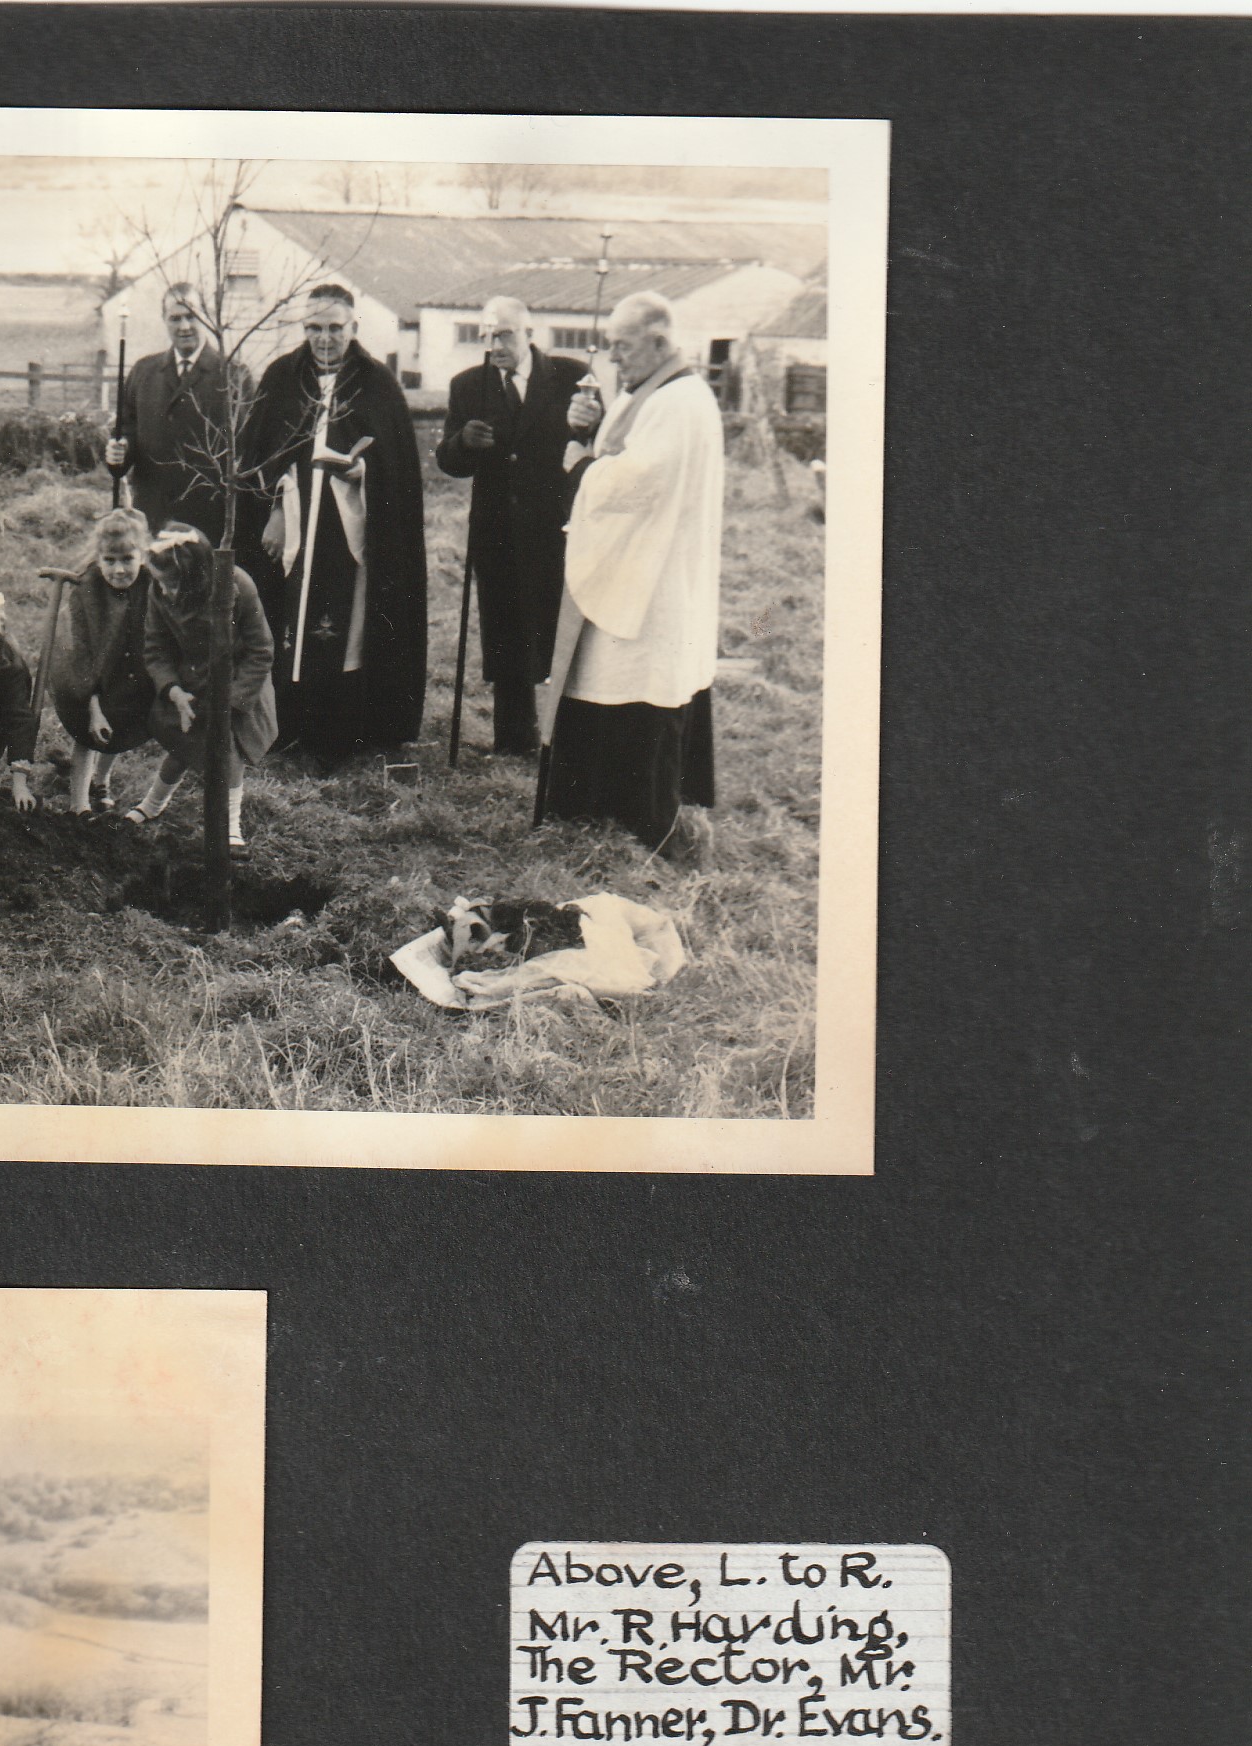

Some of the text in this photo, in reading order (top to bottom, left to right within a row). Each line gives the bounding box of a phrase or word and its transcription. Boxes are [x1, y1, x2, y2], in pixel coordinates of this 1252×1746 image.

[527, 1551, 893, 1608] Above, L. to R.
[528, 1608, 609, 1646] Mr.
[515, 1643, 916, 1697] The Rector, Mr.
[720, 1699, 784, 1739] Dr.
[798, 1694, 943, 1742] Evans.
